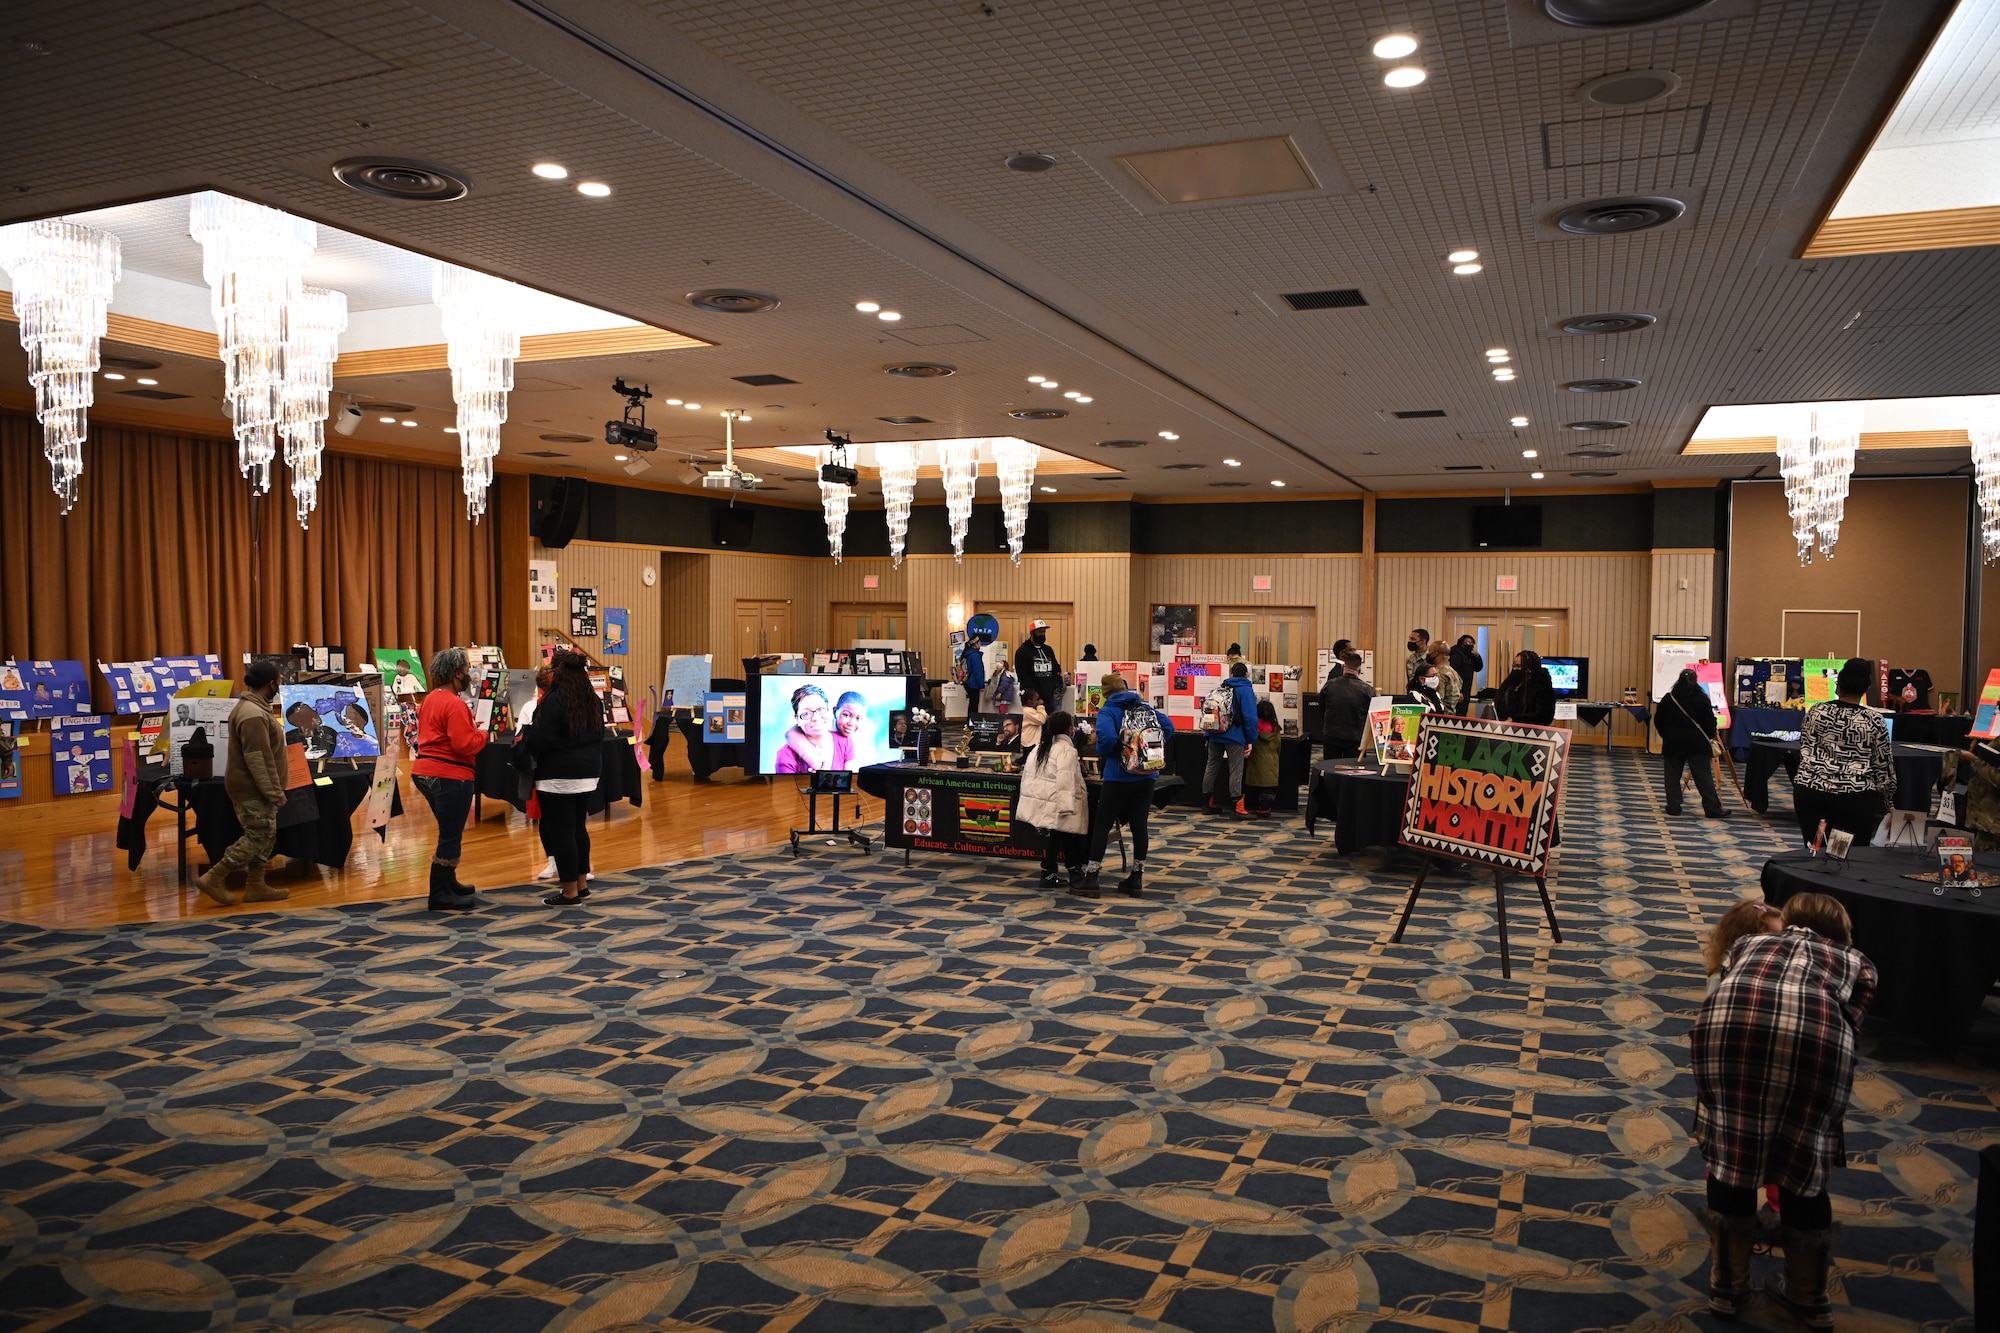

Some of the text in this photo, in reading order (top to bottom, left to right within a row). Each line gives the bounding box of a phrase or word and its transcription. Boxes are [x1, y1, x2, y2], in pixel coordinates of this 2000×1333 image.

[143, 718, 161, 726] NEIL
[1436, 731, 1535, 781] BLACK
[918, 777, 1017, 792] African American Heritage
[1419, 762, 1545, 819] HISTORY
[1416, 797, 1530, 854] MONTH
[1945, 838, 1965, 846] 100
